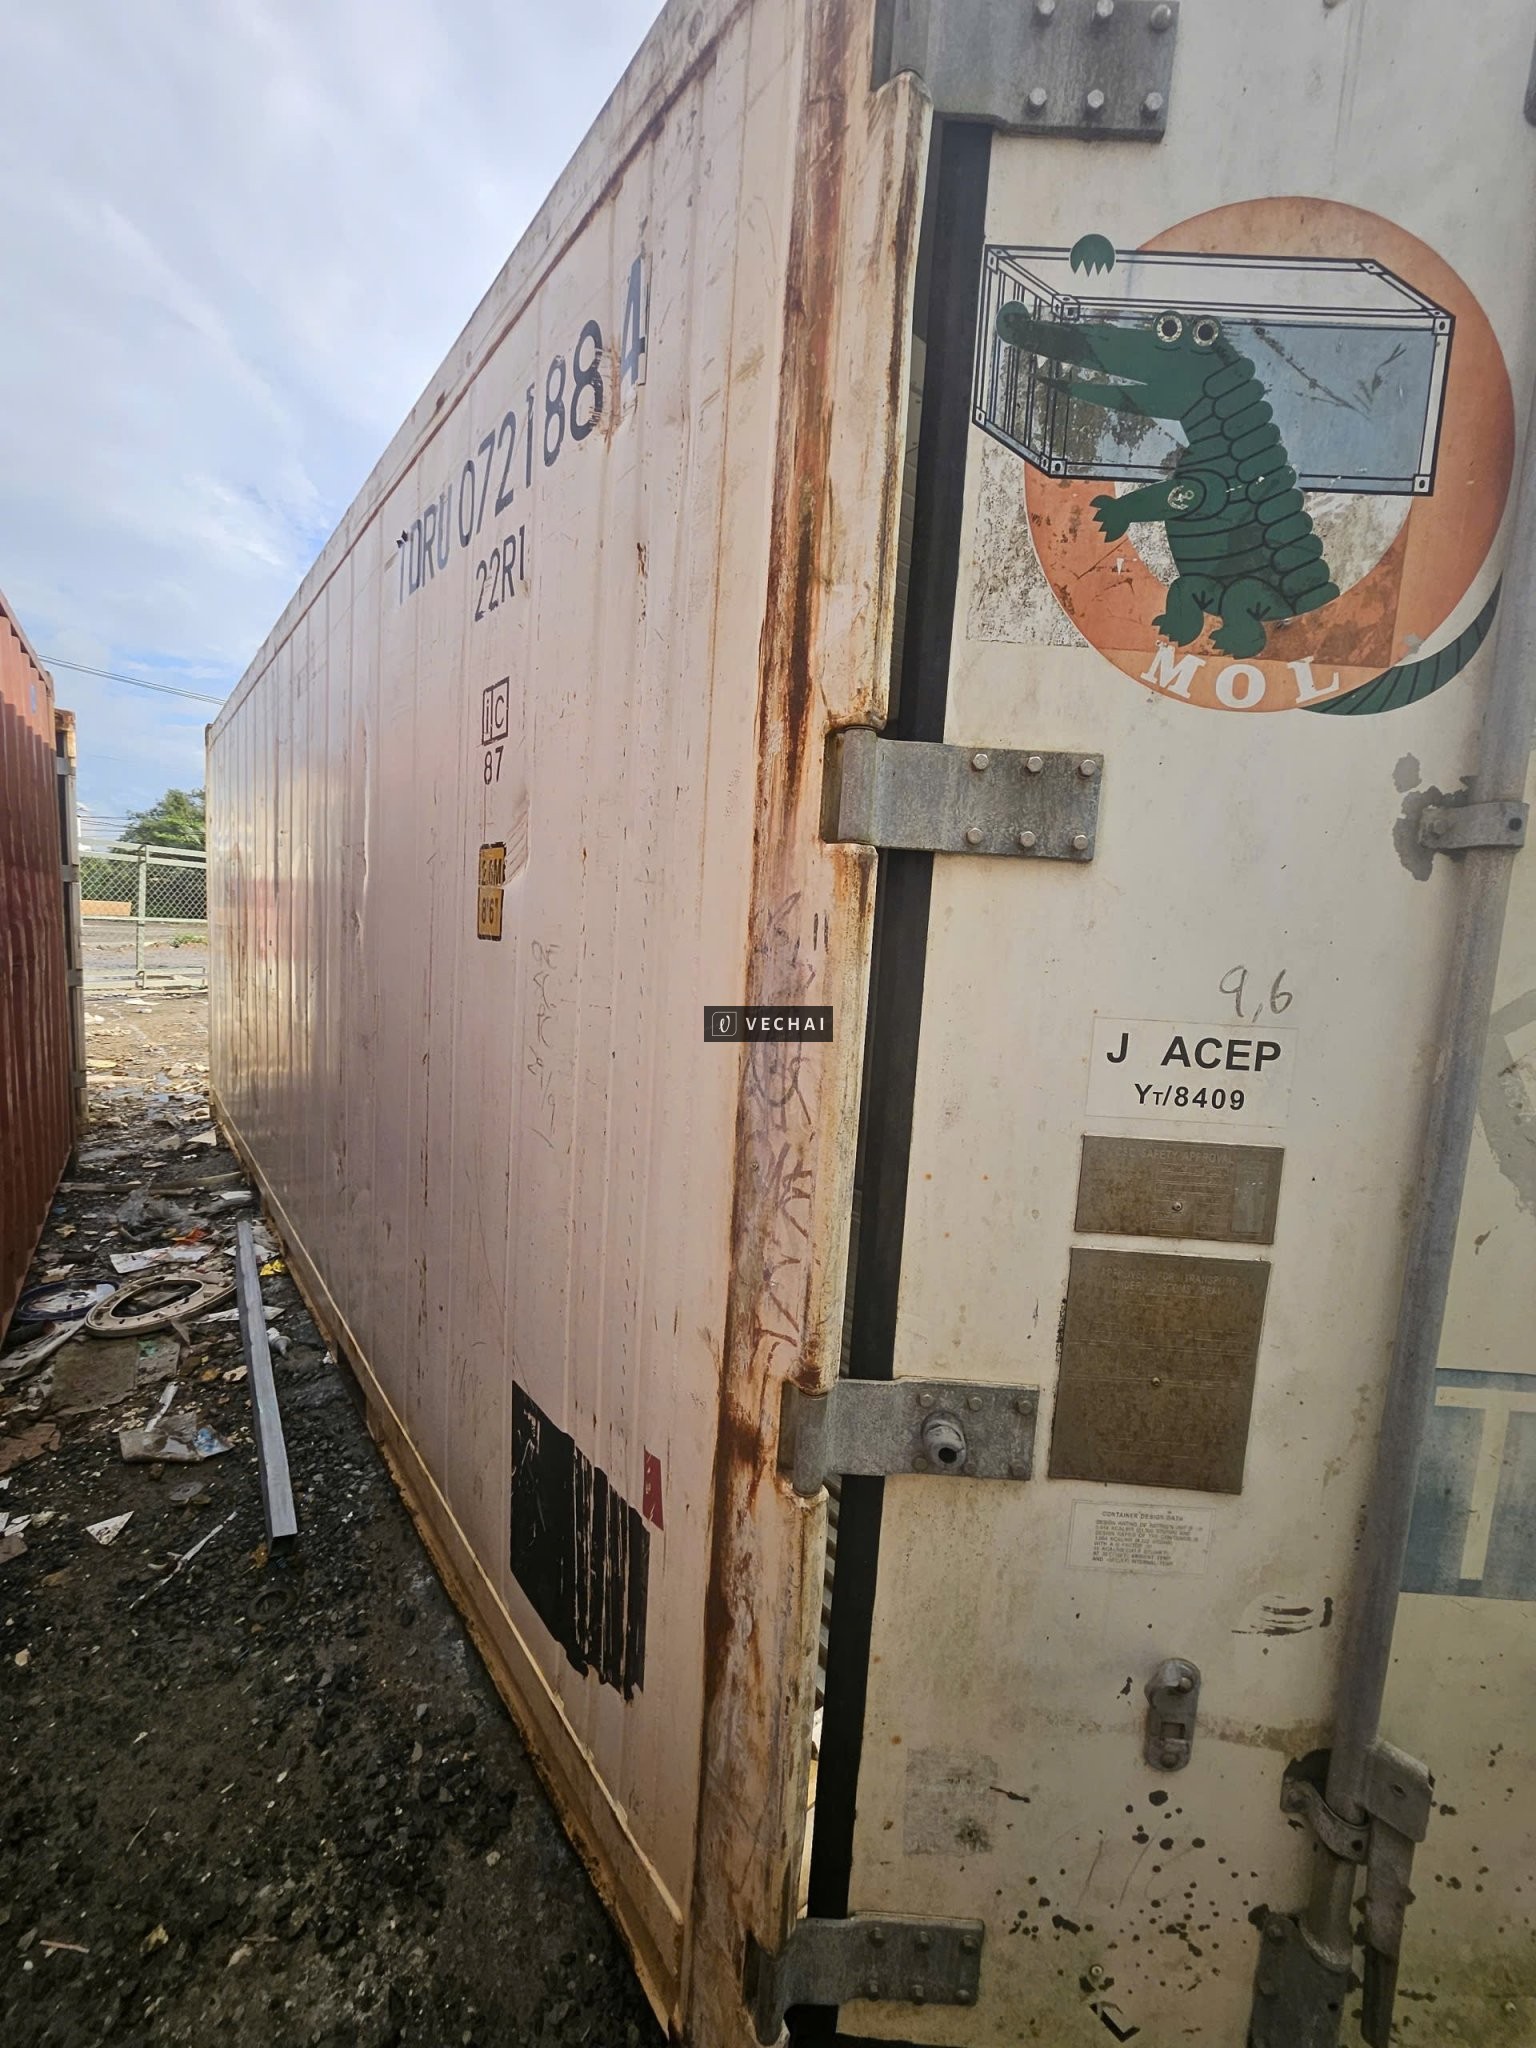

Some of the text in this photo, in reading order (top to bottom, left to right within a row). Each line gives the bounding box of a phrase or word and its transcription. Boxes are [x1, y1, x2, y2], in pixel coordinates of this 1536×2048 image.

[1140, 641, 1341, 709] MOL
[484, 745, 504, 785] 87
[1106, 1033, 1282, 1072] J ACEP
